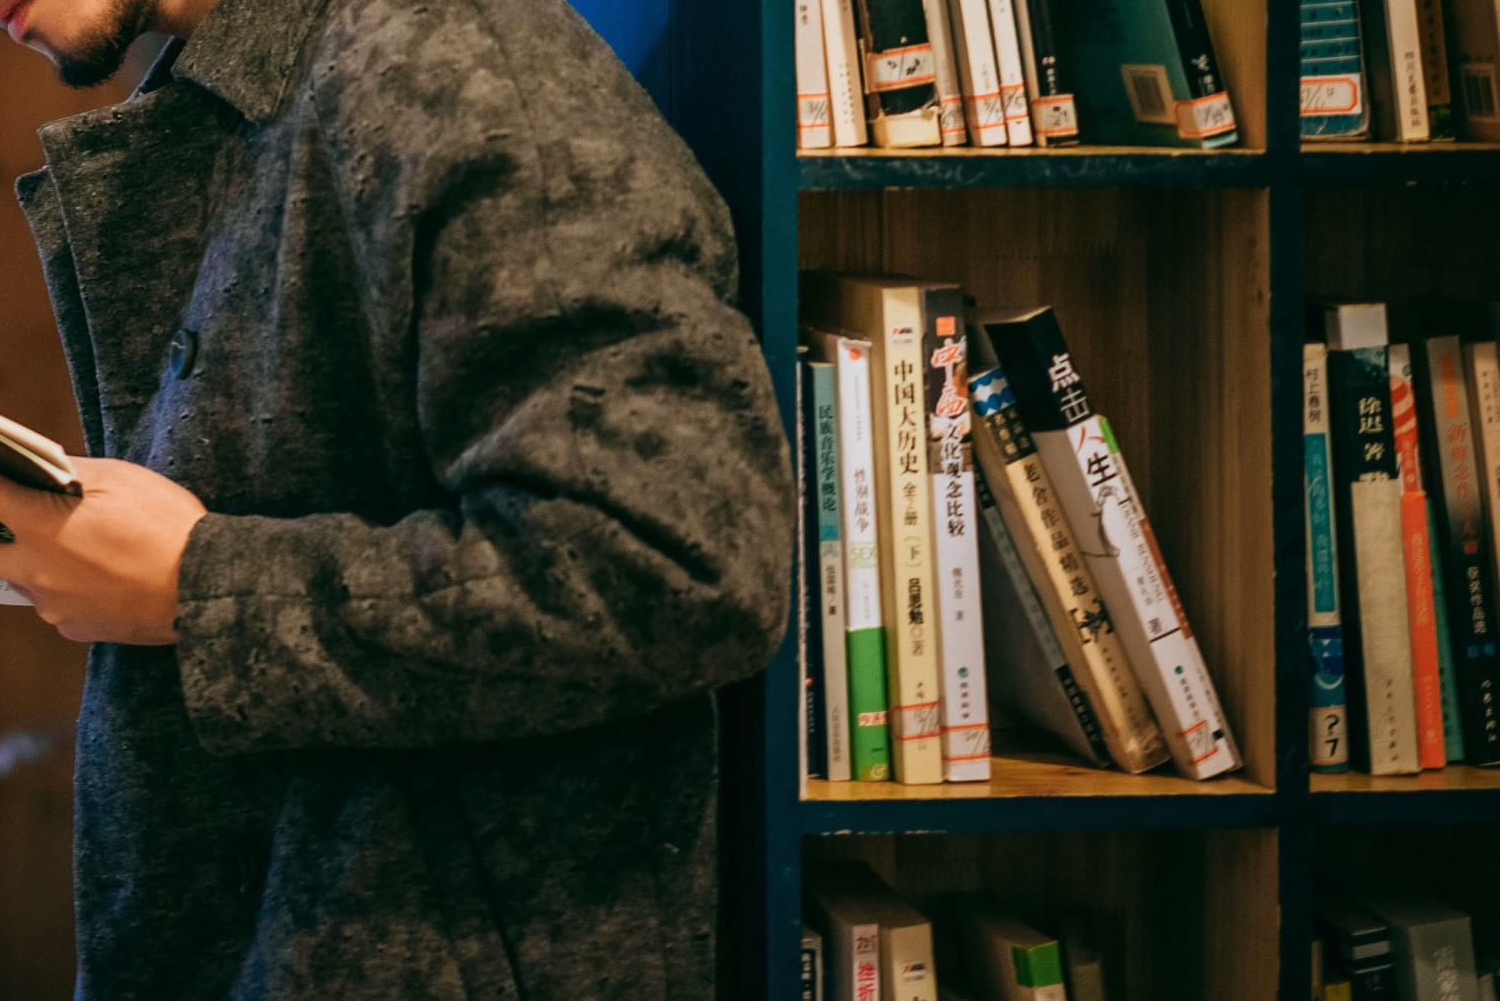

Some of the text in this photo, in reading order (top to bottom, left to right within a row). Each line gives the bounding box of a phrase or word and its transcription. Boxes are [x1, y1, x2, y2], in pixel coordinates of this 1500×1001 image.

[894, 359, 918, 475] 中国大历史
[1048, 353, 1118, 488] 点击人生
